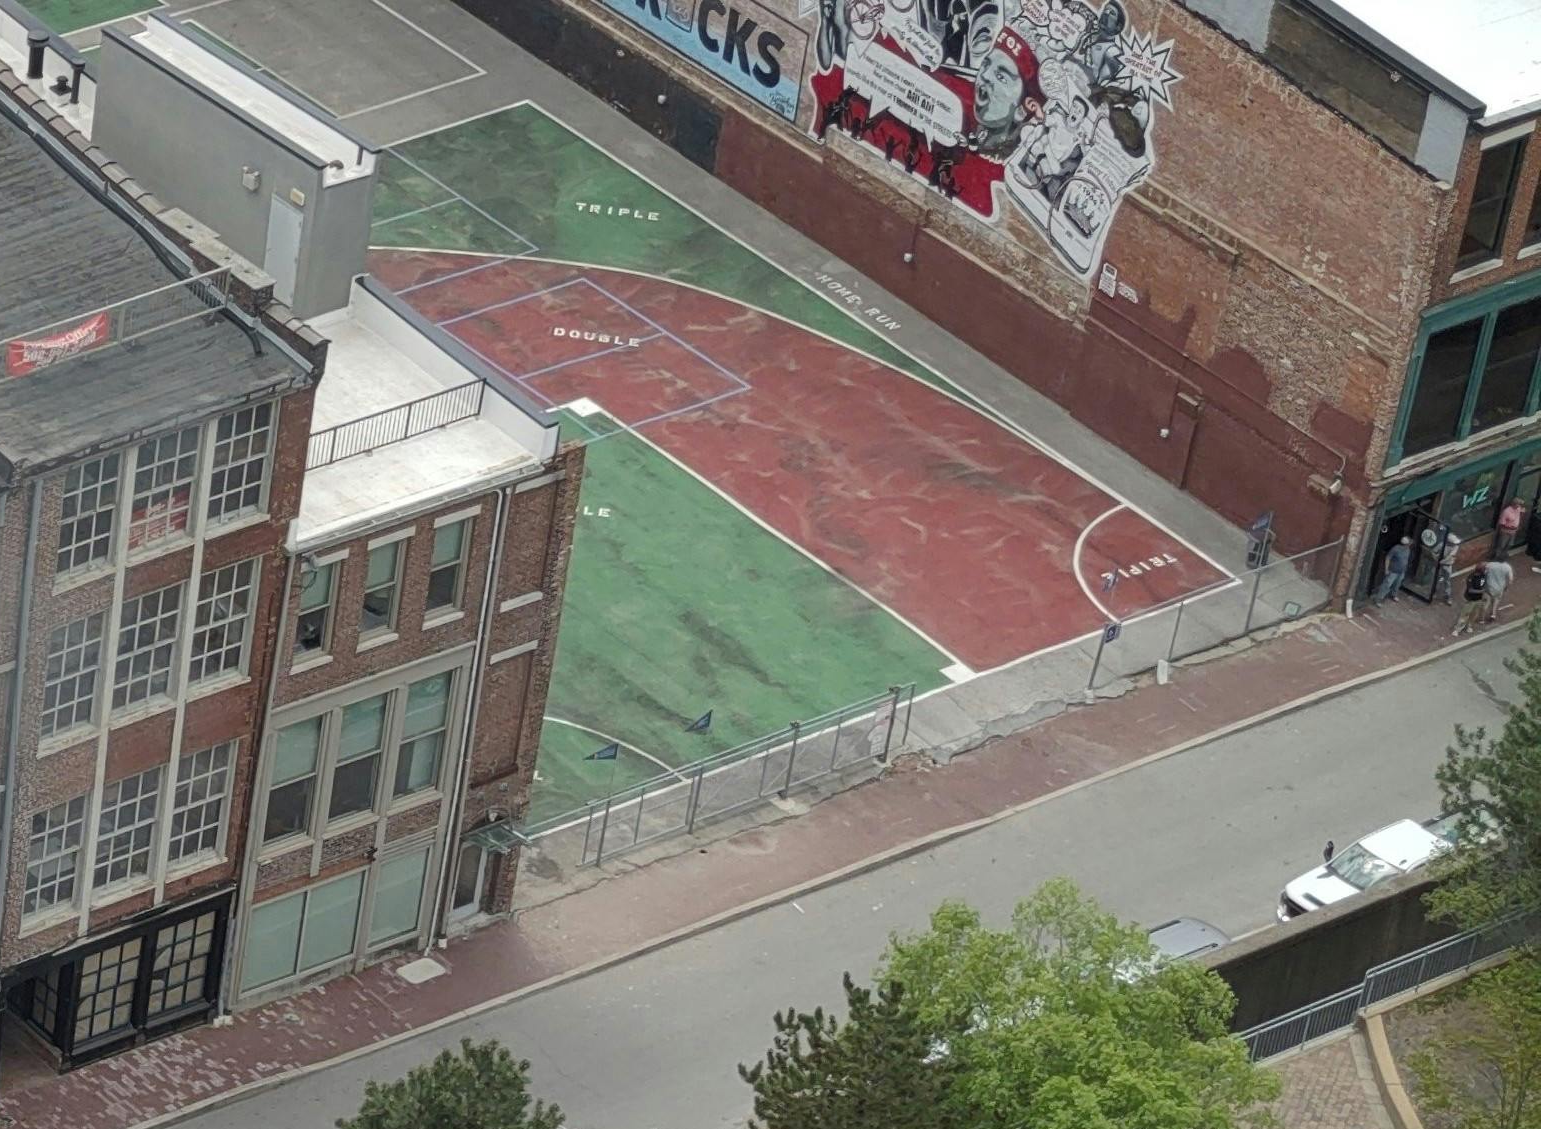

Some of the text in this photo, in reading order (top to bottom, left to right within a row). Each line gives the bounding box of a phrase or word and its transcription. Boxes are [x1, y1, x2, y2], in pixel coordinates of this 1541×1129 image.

[575, 202, 660, 221] TRIPLE
[816, 274, 901, 330] HOME RUN
[553, 327, 640, 348] DOUBLE
